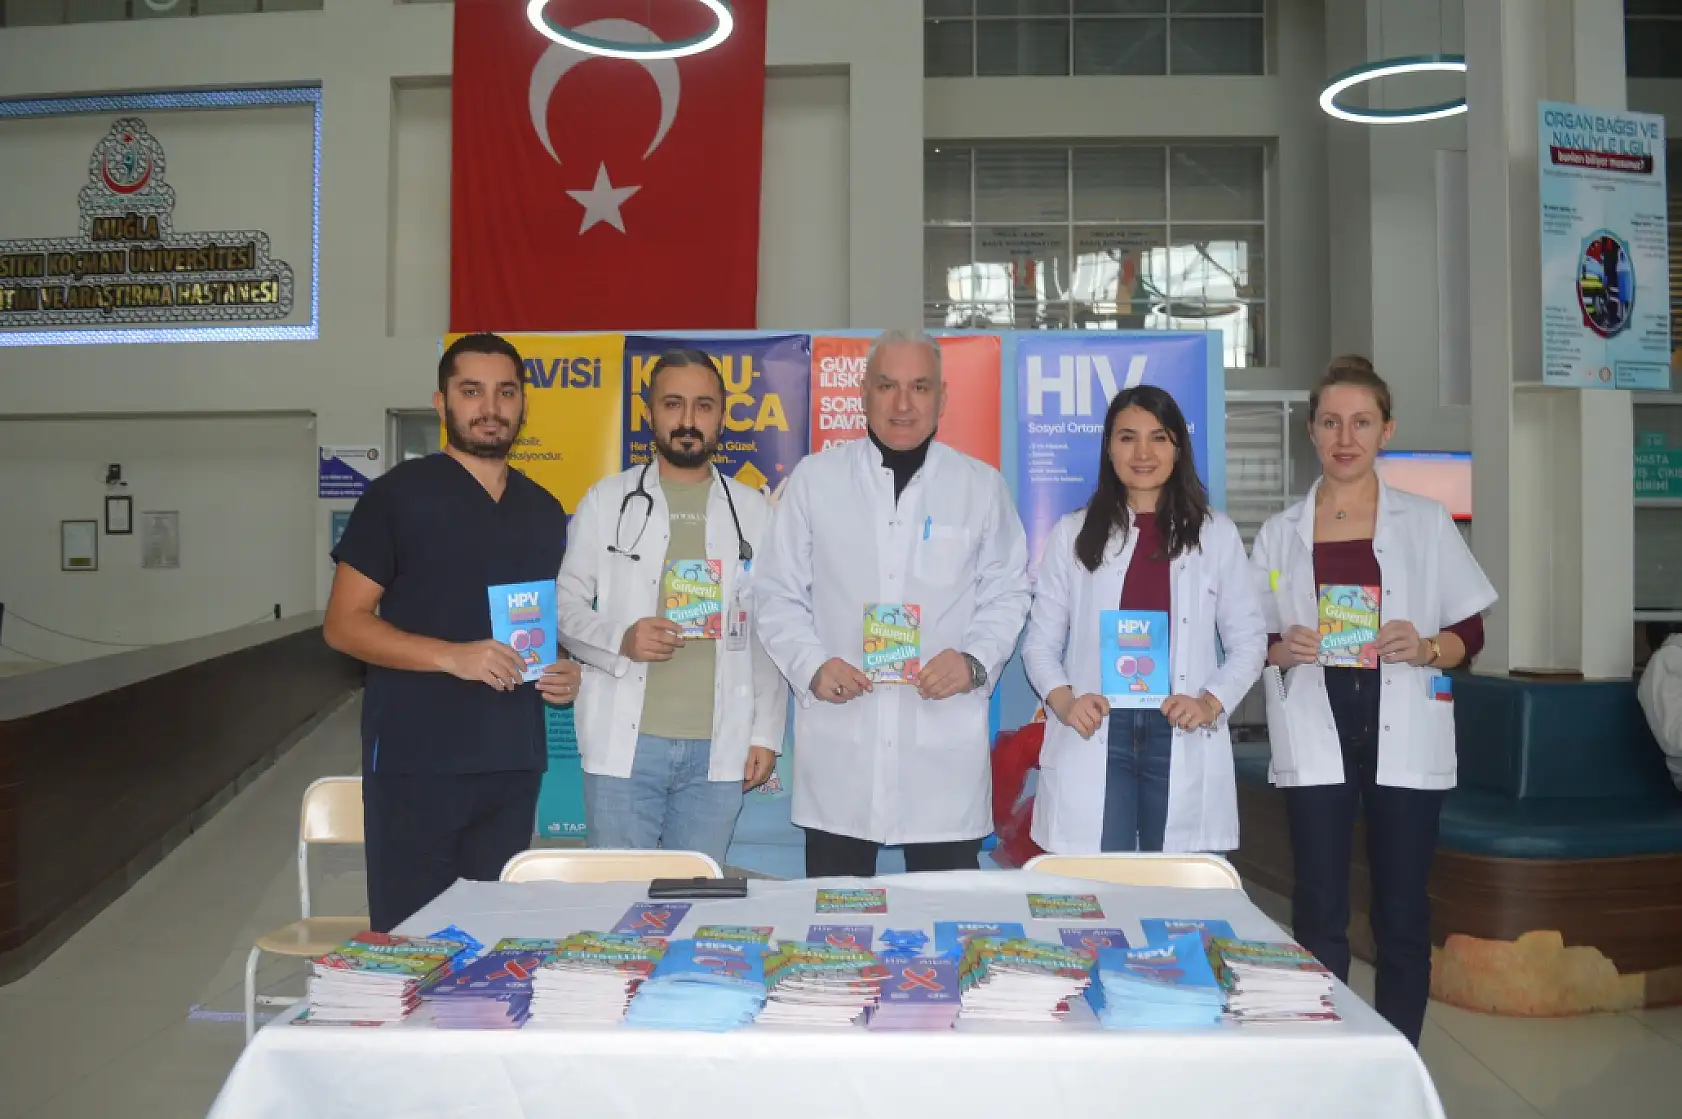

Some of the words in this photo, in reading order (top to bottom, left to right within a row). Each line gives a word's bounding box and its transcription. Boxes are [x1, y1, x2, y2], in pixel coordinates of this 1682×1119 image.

[1544, 110, 1593, 131] ORGAN
[1640, 121, 1658, 139] VE
[93, 212, 160, 241] MUĞLA
[128, 242, 254, 272] ÜNİVERSİTESİ
[176, 274, 279, 305] HASTANESİ
[1026, 355, 1148, 416] HIV
[1028, 422, 1066, 436] Sosyal
[671, 578, 717, 599] Güvenli
[508, 591, 539, 609] HPV
[669, 601, 719, 622] Cinsellik
[1325, 604, 1373, 628] Güvenli
[870, 622, 915, 643] Güvenli
[1118, 619, 1151, 635] HPV
